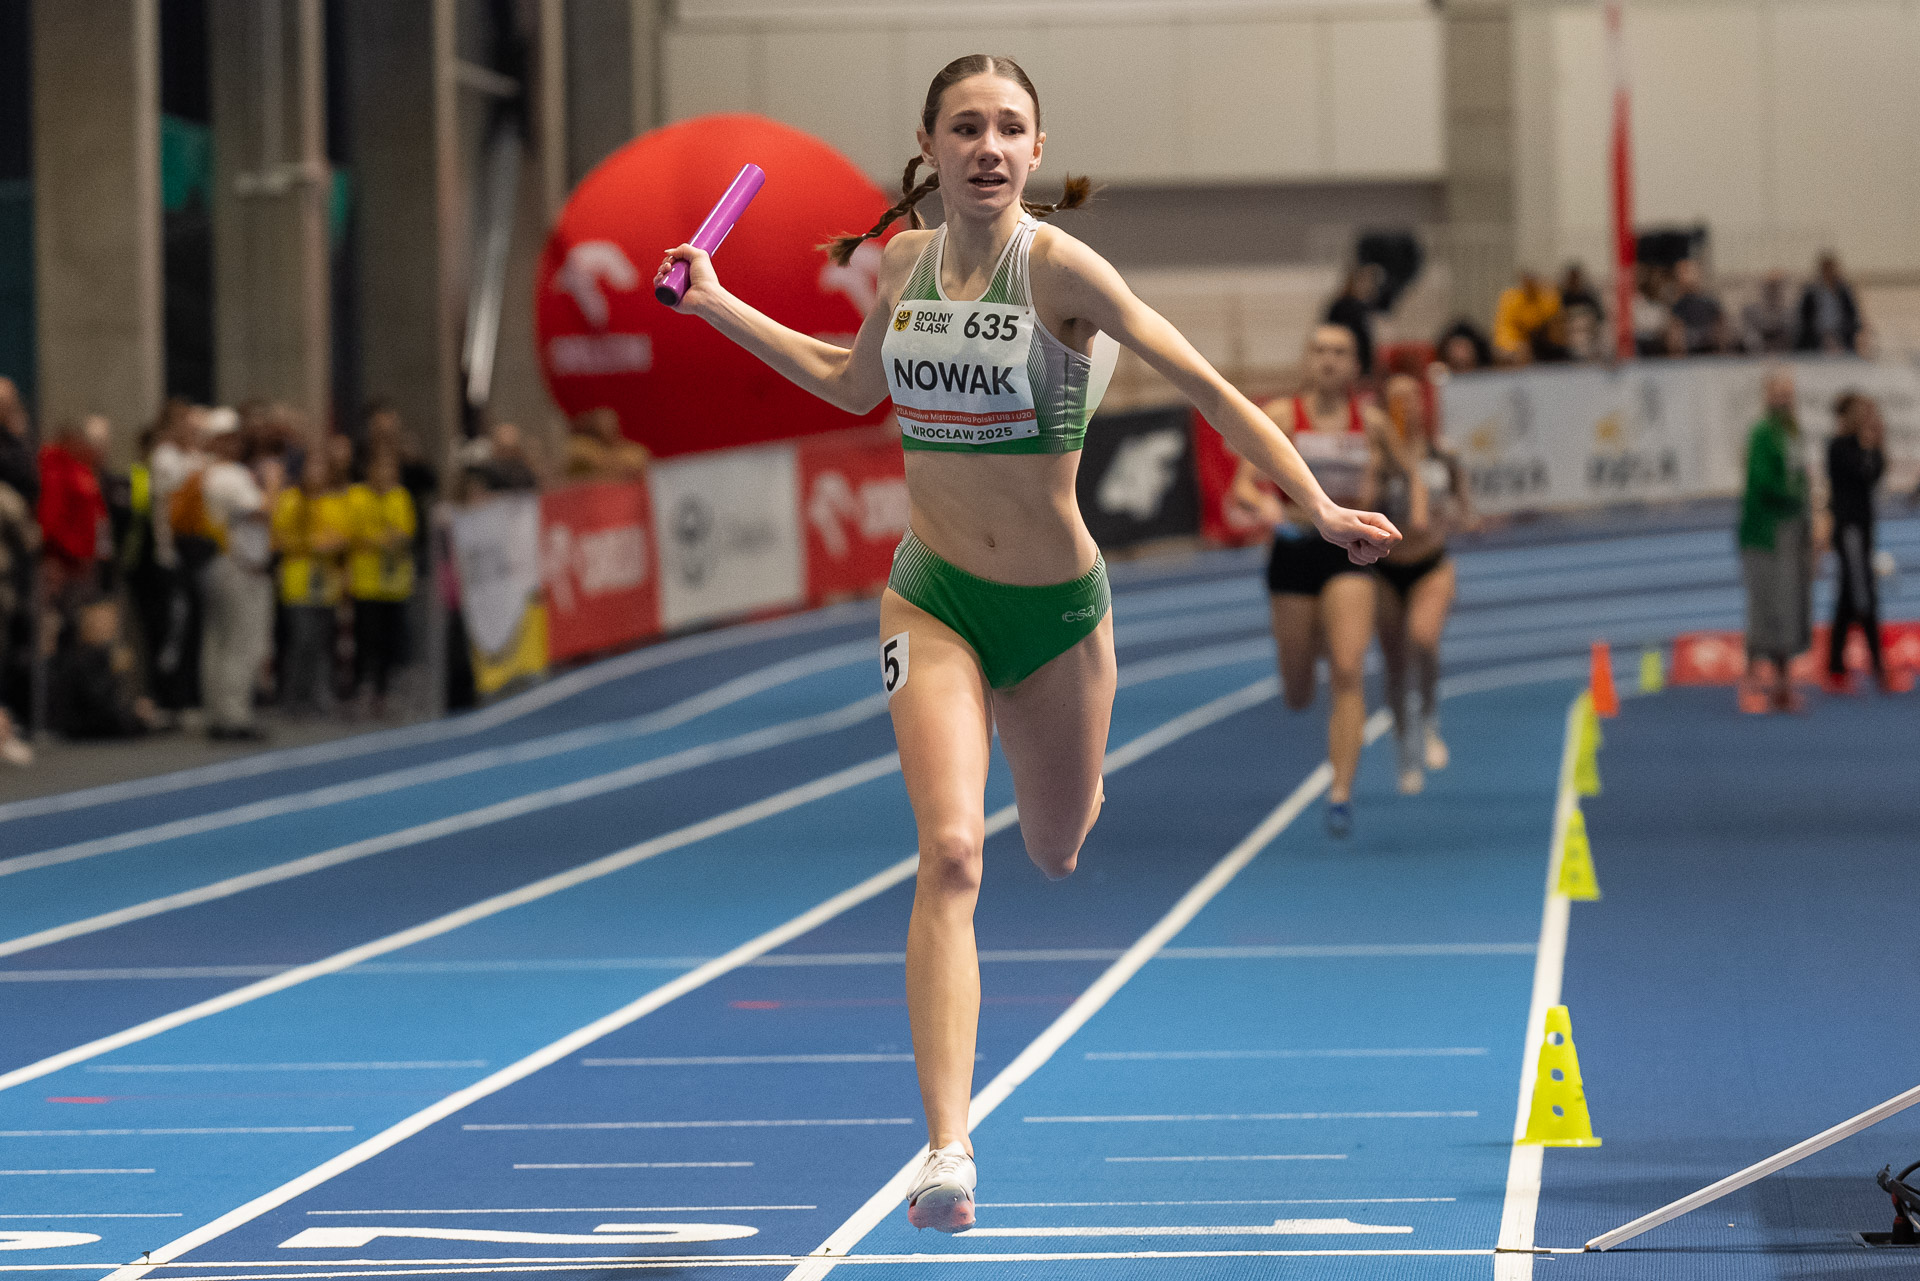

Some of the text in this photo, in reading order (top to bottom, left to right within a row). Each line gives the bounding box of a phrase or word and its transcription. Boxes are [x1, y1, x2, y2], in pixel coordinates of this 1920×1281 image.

[916, 310, 953, 323] DOLNY
[913, 320, 950, 334] ŚLĄSK
[963, 311, 1019, 341] 635
[894, 357, 1018, 396] NOWAK
[930, 413, 972, 423] Mistrzostwa
[972, 415, 995, 424] Polski
[996, 414, 1011, 422] U18
[1016, 411, 1032, 420] U20
[911, 424, 1013, 441] WROCŁAW 2025
[883, 638, 900, 692] 5
